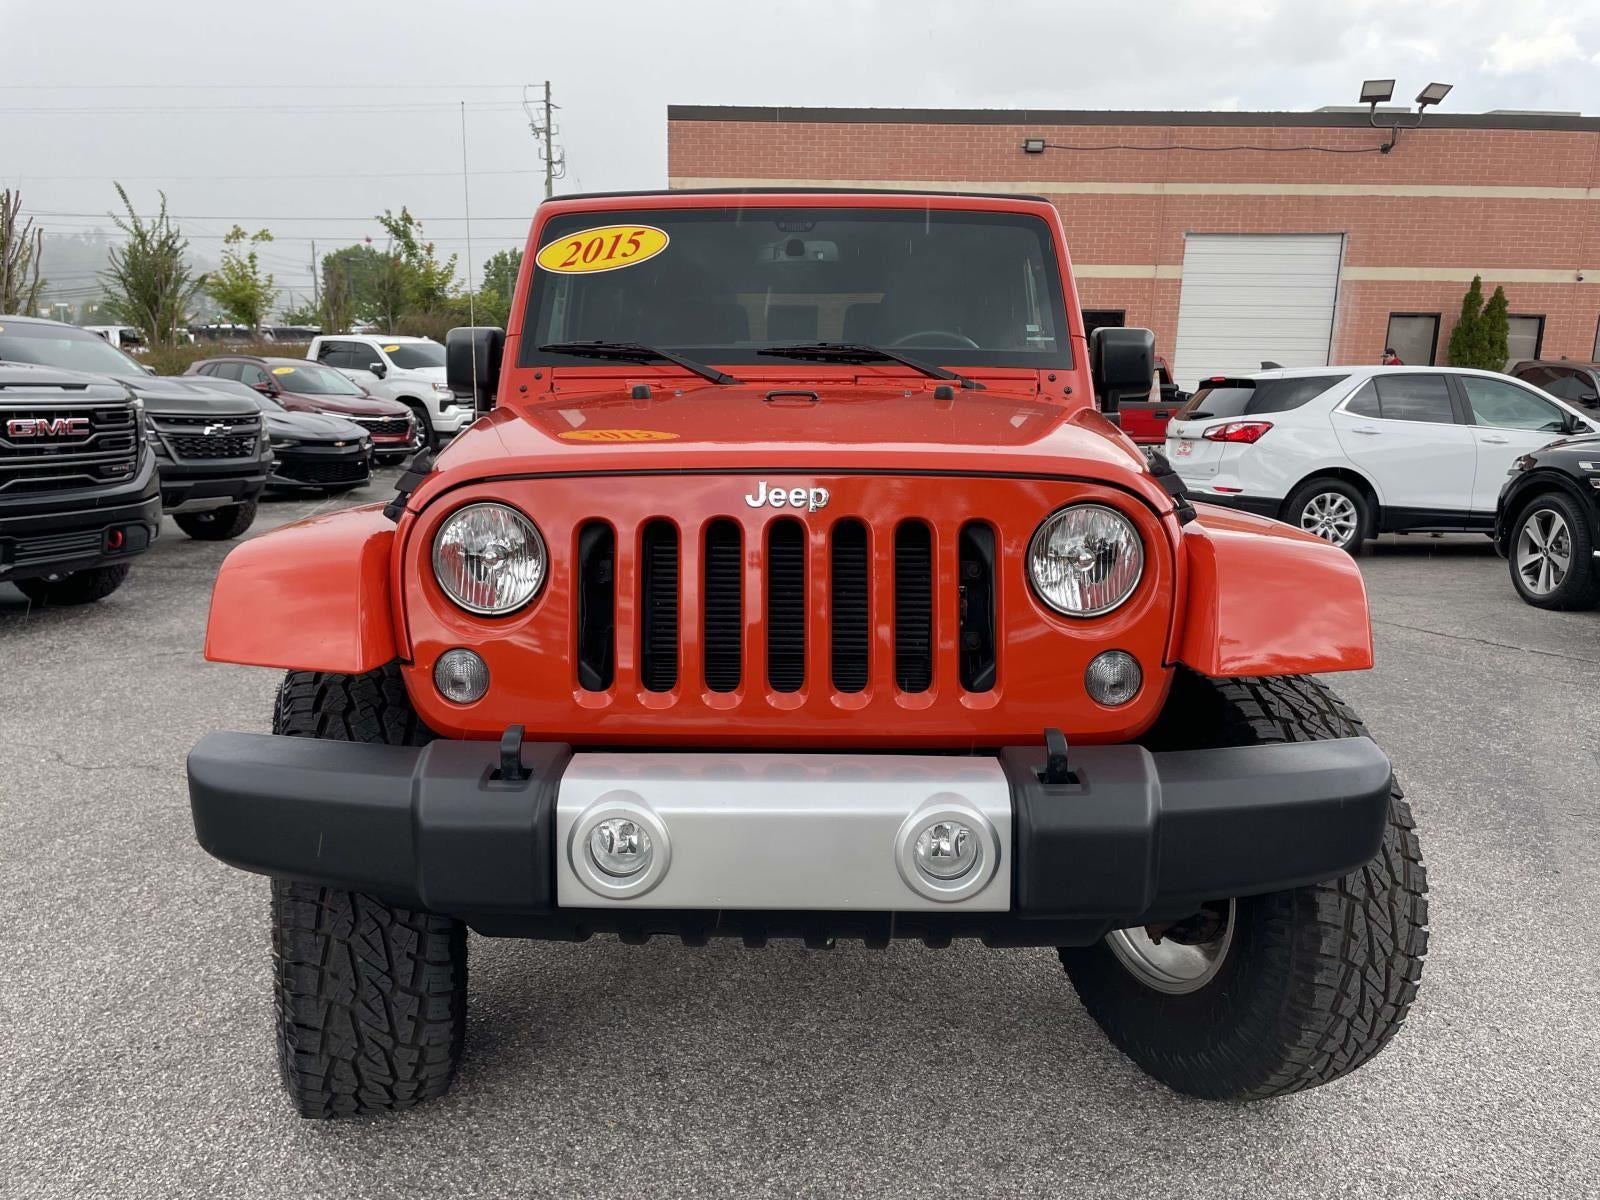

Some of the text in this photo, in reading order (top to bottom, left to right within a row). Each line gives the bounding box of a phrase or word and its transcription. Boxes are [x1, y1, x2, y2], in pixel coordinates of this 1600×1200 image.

[559, 230, 645, 268] 2015
[6, 417, 89, 437] GMC
[745, 481, 830, 513] Jeep
